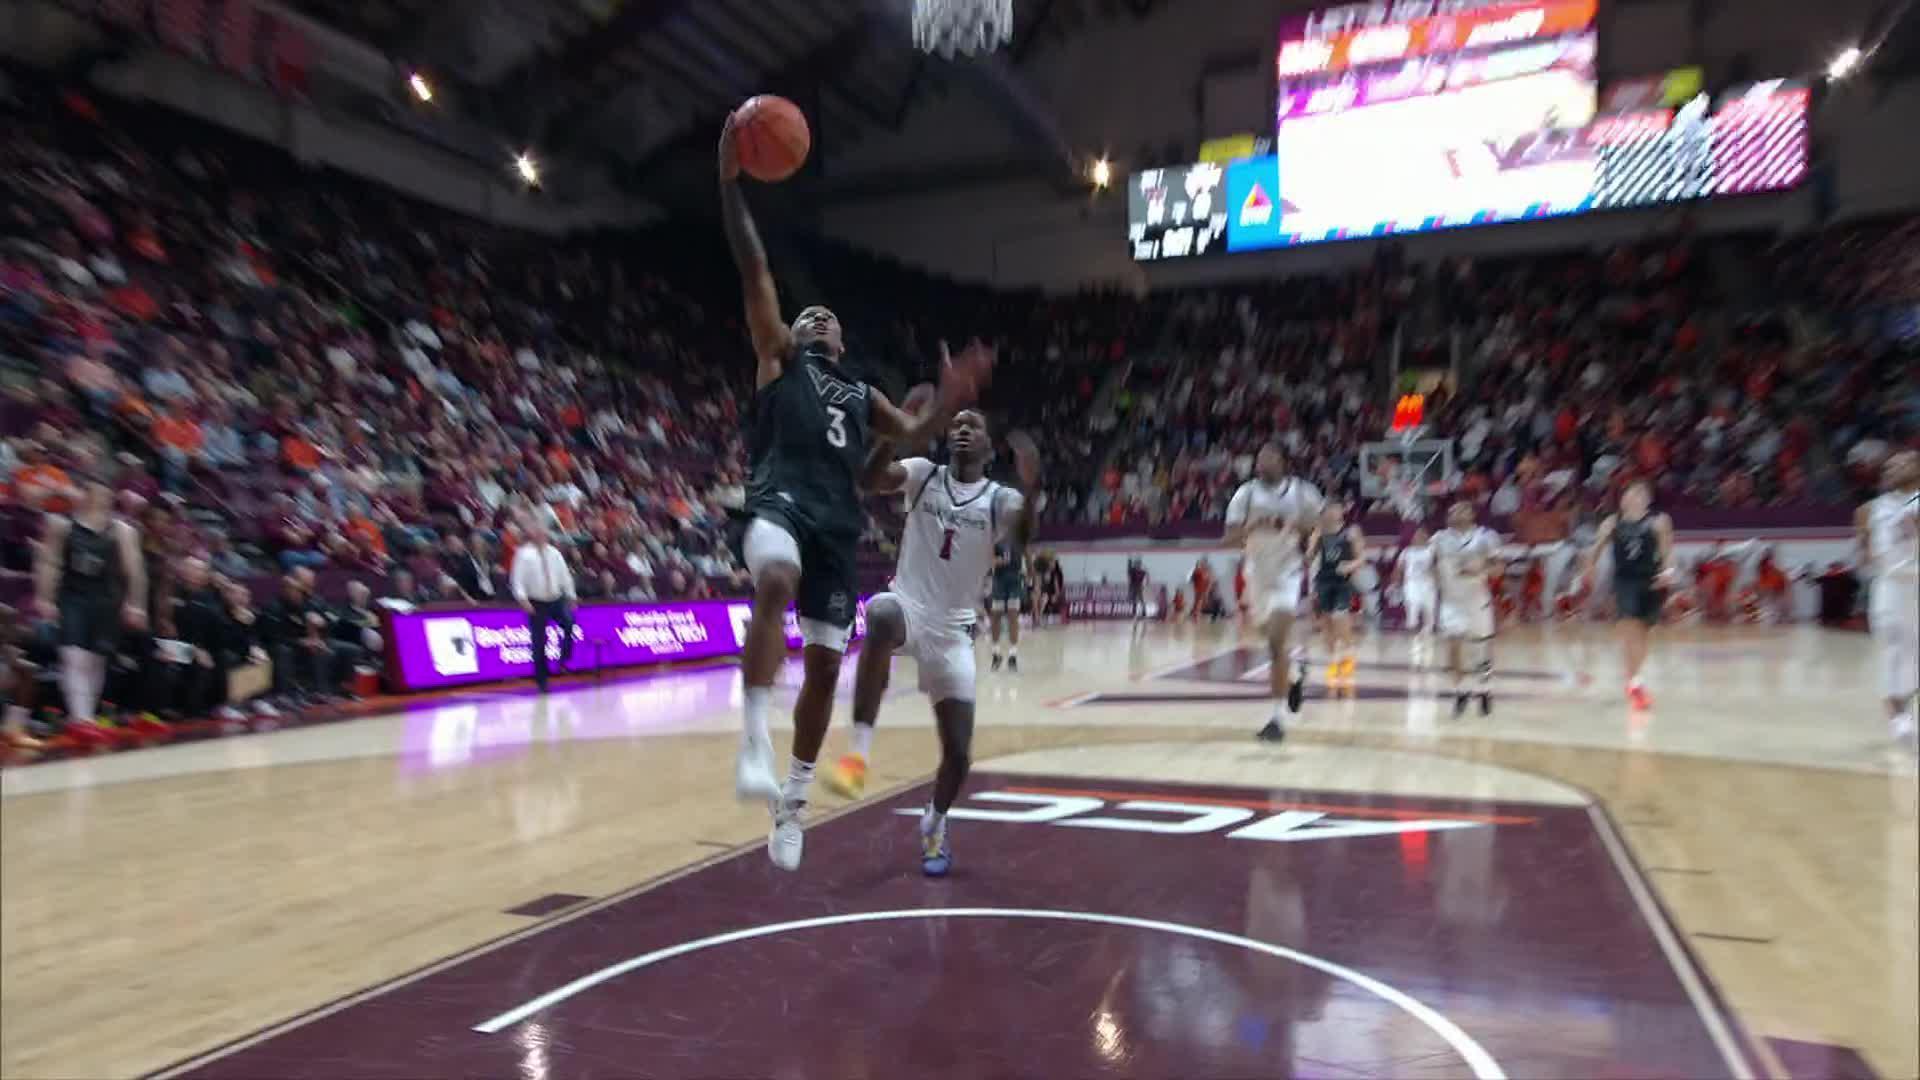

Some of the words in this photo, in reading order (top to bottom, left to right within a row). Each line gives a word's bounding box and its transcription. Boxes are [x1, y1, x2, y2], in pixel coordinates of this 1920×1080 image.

[826, 405, 847, 448] 3
[939, 527, 955, 561] 1
[894, 791, 1484, 842] ACC
